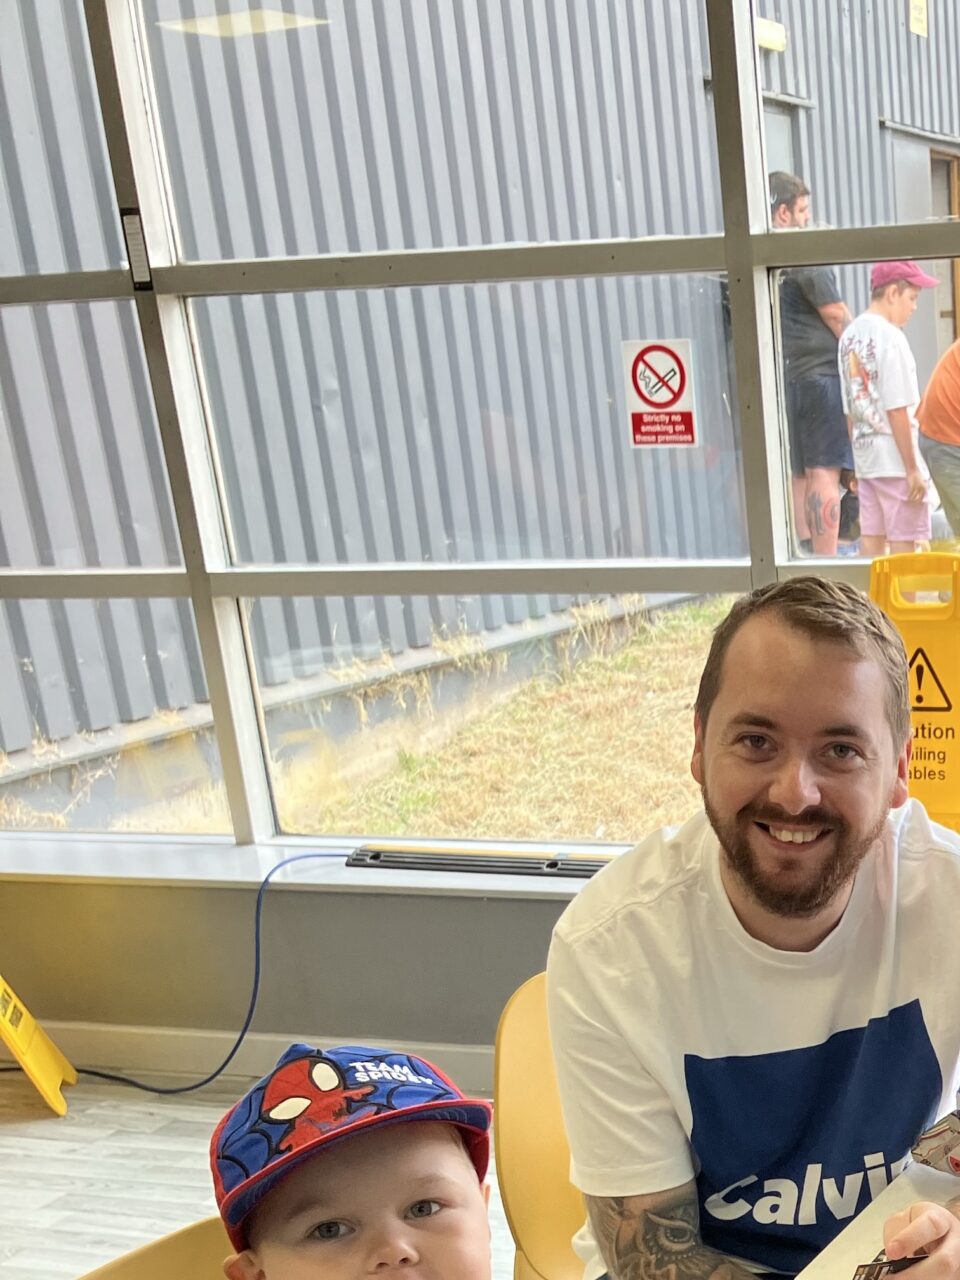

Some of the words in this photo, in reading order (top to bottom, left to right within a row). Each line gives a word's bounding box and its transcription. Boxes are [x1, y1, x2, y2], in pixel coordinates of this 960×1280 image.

[642, 413, 670, 424] Strictly
[671, 414, 682, 423] no
[641, 424, 674, 434] smoking
[674, 424, 686, 432] on
[635, 434, 657, 443] these
[657, 434, 693, 444] premises
[912, 747, 946, 764] iling
[349, 1062, 414, 1078] TEAM
[704, 1151, 906, 1225] Calvi
